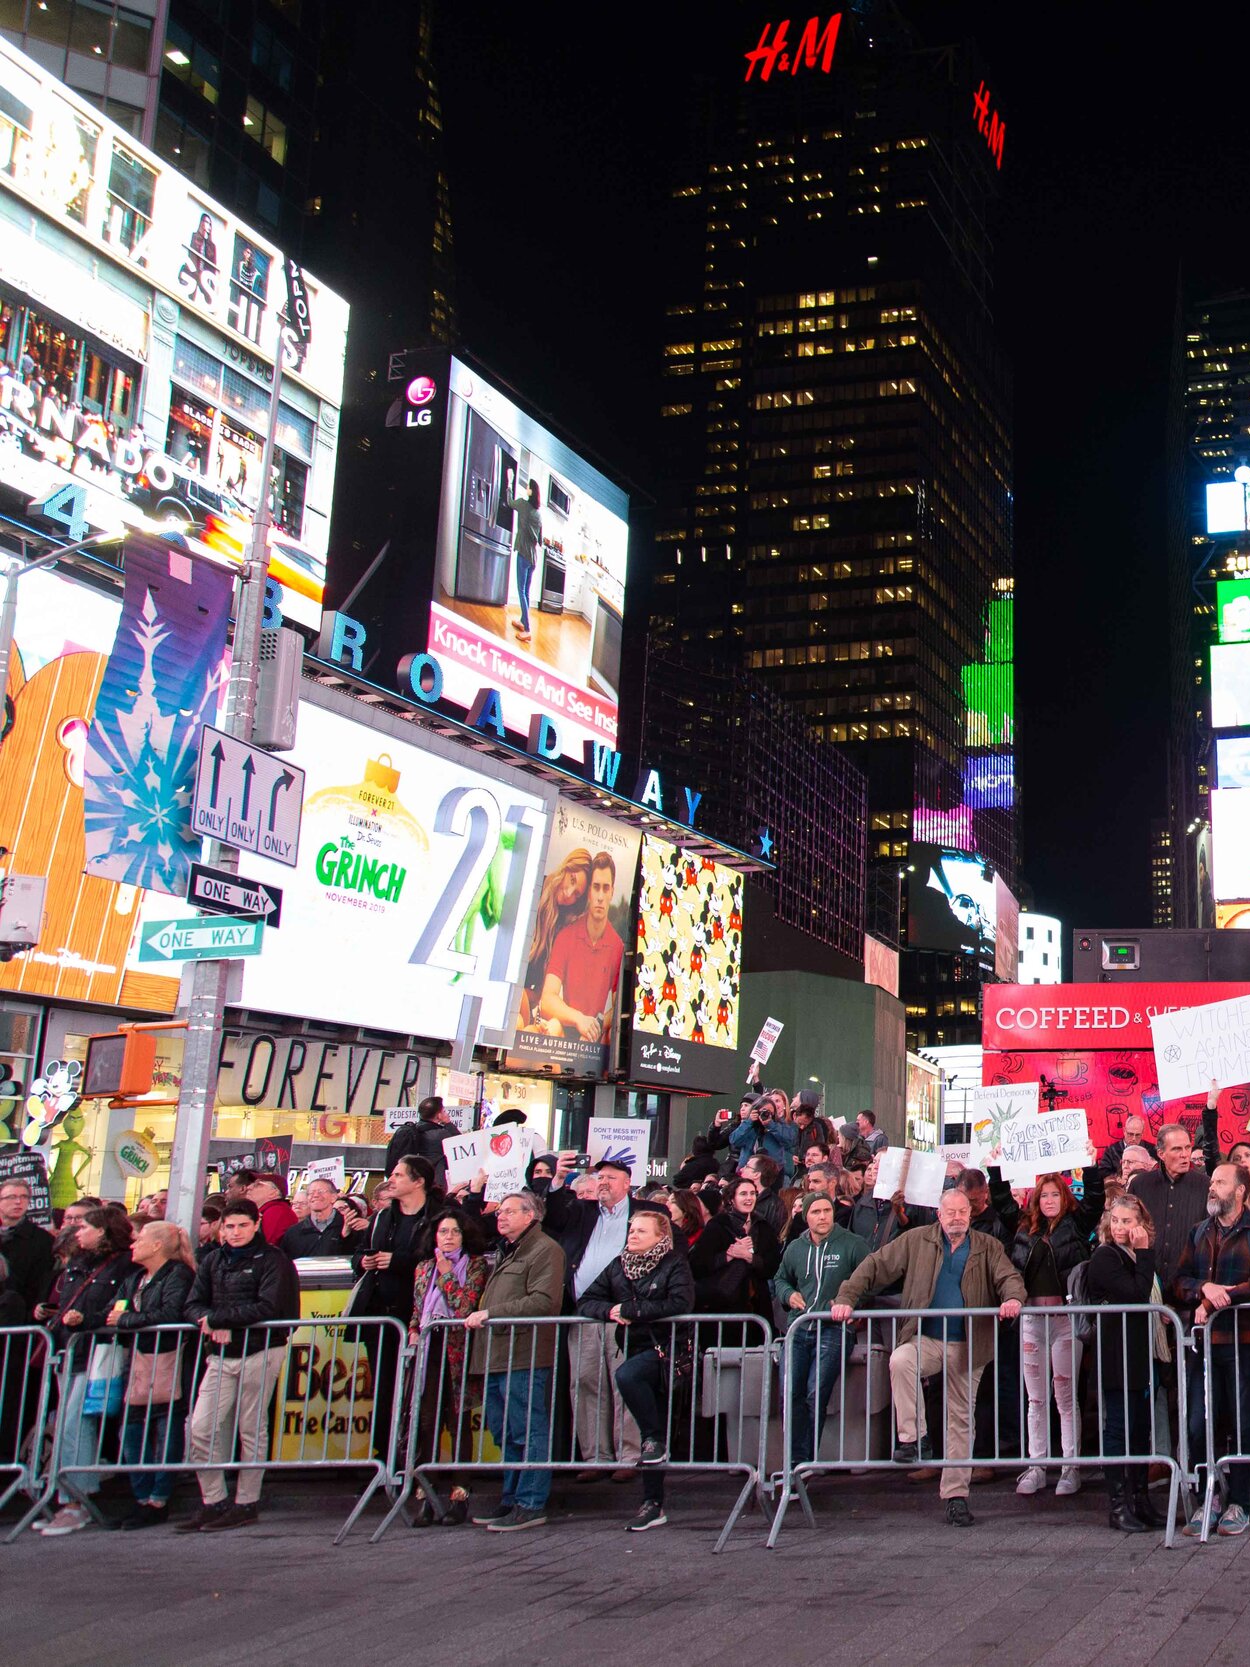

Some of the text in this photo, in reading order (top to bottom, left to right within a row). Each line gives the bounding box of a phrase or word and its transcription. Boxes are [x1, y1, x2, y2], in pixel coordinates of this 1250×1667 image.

[745, 13, 842, 82] H&M
[973, 80, 1005, 170] H&M
[223, 343, 274, 381] TOPSHO
[182, 403, 214, 429] BLACK
[405, 410, 432, 428] LG
[434, 619, 488, 665] Knock
[489, 648, 534, 690] Twice
[534, 668, 566, 708] And
[566, 690, 594, 722] See
[358, 789, 395, 811] FOREVER 21
[199, 810, 226, 833] ONLY
[572, 817, 629, 849] U.S. POLO ASSN.
[231, 824, 256, 845] ONLY
[264, 834, 293, 858] ONLY
[315, 841, 407, 904] GRINCH
[203, 880, 270, 914] ONE WAY
[408, 786, 549, 985] 21
[324, 891, 369, 911] NOVEMBER
[159, 927, 249, 949] ONE WAY
[995, 1006, 1131, 1031] COFFEED
[1133, 1012, 1143, 1025] &
[520, 1034, 601, 1054] LIVE AUTHENTICALLY
[217, 1030, 420, 1116] FOREVER
[973, 1087, 1039, 1100] Defend Democracy
[389, 1109, 464, 1119] PEDESTRI ZONE
[120, 1145, 150, 1173] GRINCH
[451, 1142, 477, 1162] IM
[14, 1163, 34, 1174] End:
[350, 1171, 370, 1195] 21
[283, 1409, 318, 1435] The
